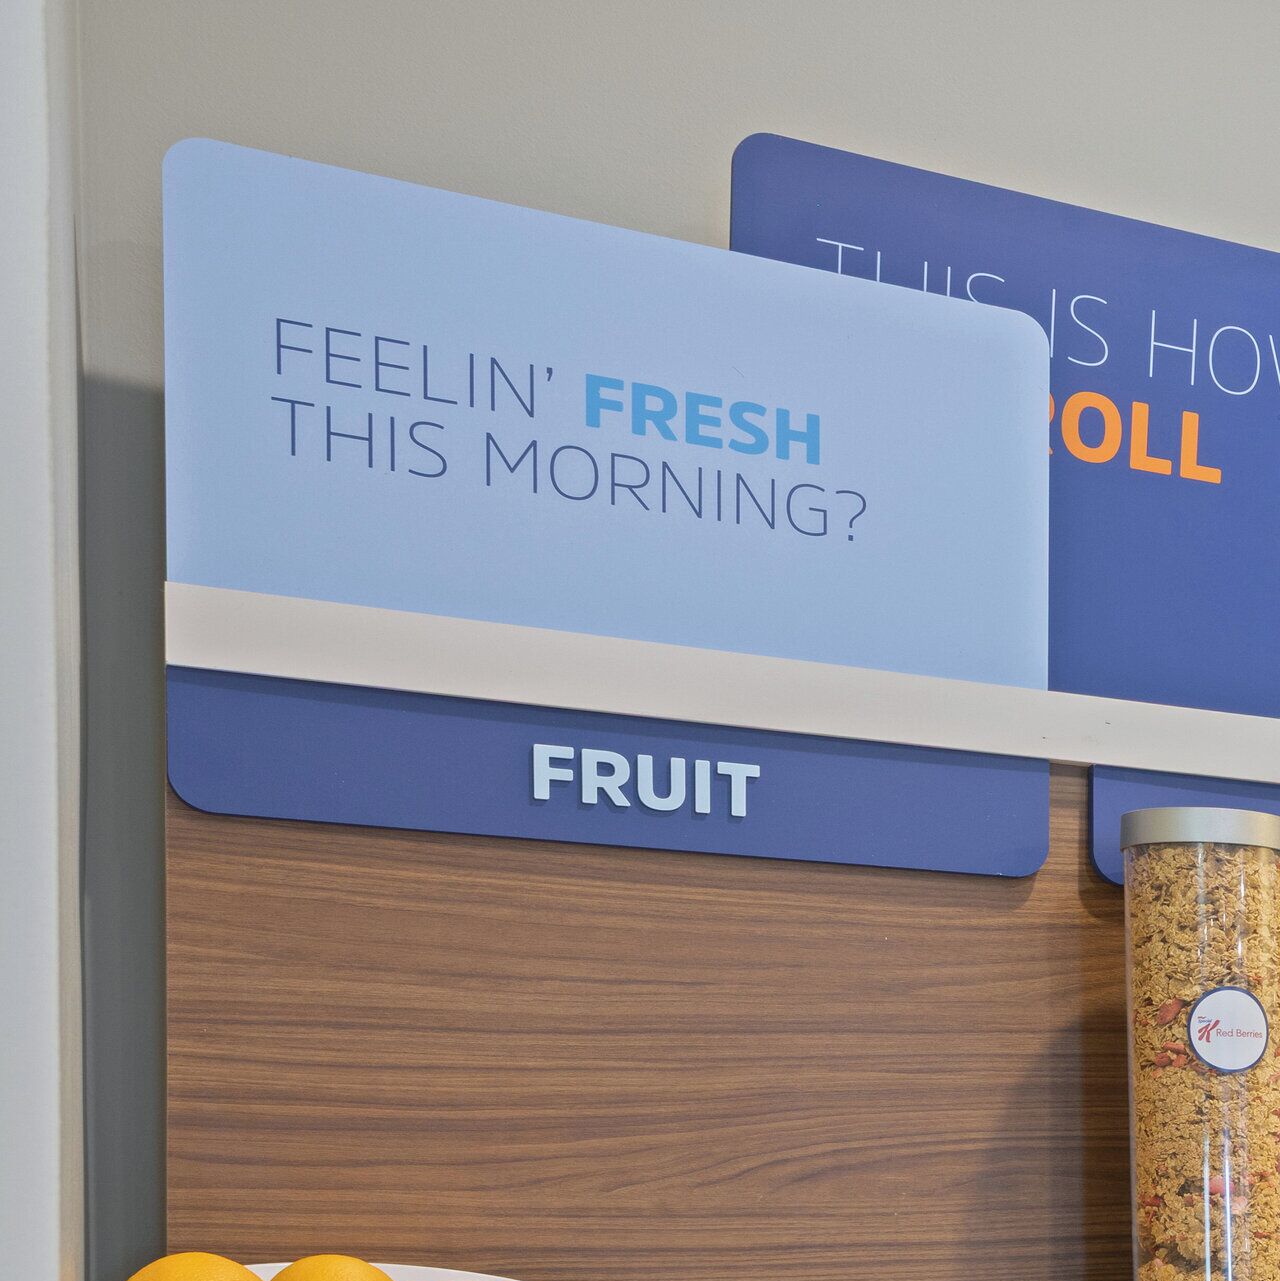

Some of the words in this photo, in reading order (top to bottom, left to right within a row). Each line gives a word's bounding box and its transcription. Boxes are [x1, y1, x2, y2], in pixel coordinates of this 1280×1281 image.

[1050, 289, 1109, 368] IS
[584, 374, 821, 466] FRESH
[1049, 391, 1222, 484] OLL
[271, 396, 449, 479] THIS
[485, 431, 868, 543] MORNING?
[532, 743, 761, 818] FRUIT
[1198, 1019, 1220, 1043] K
[1216, 1028, 1234, 1037] Red
[1236, 1028, 1263, 1039] Berries
